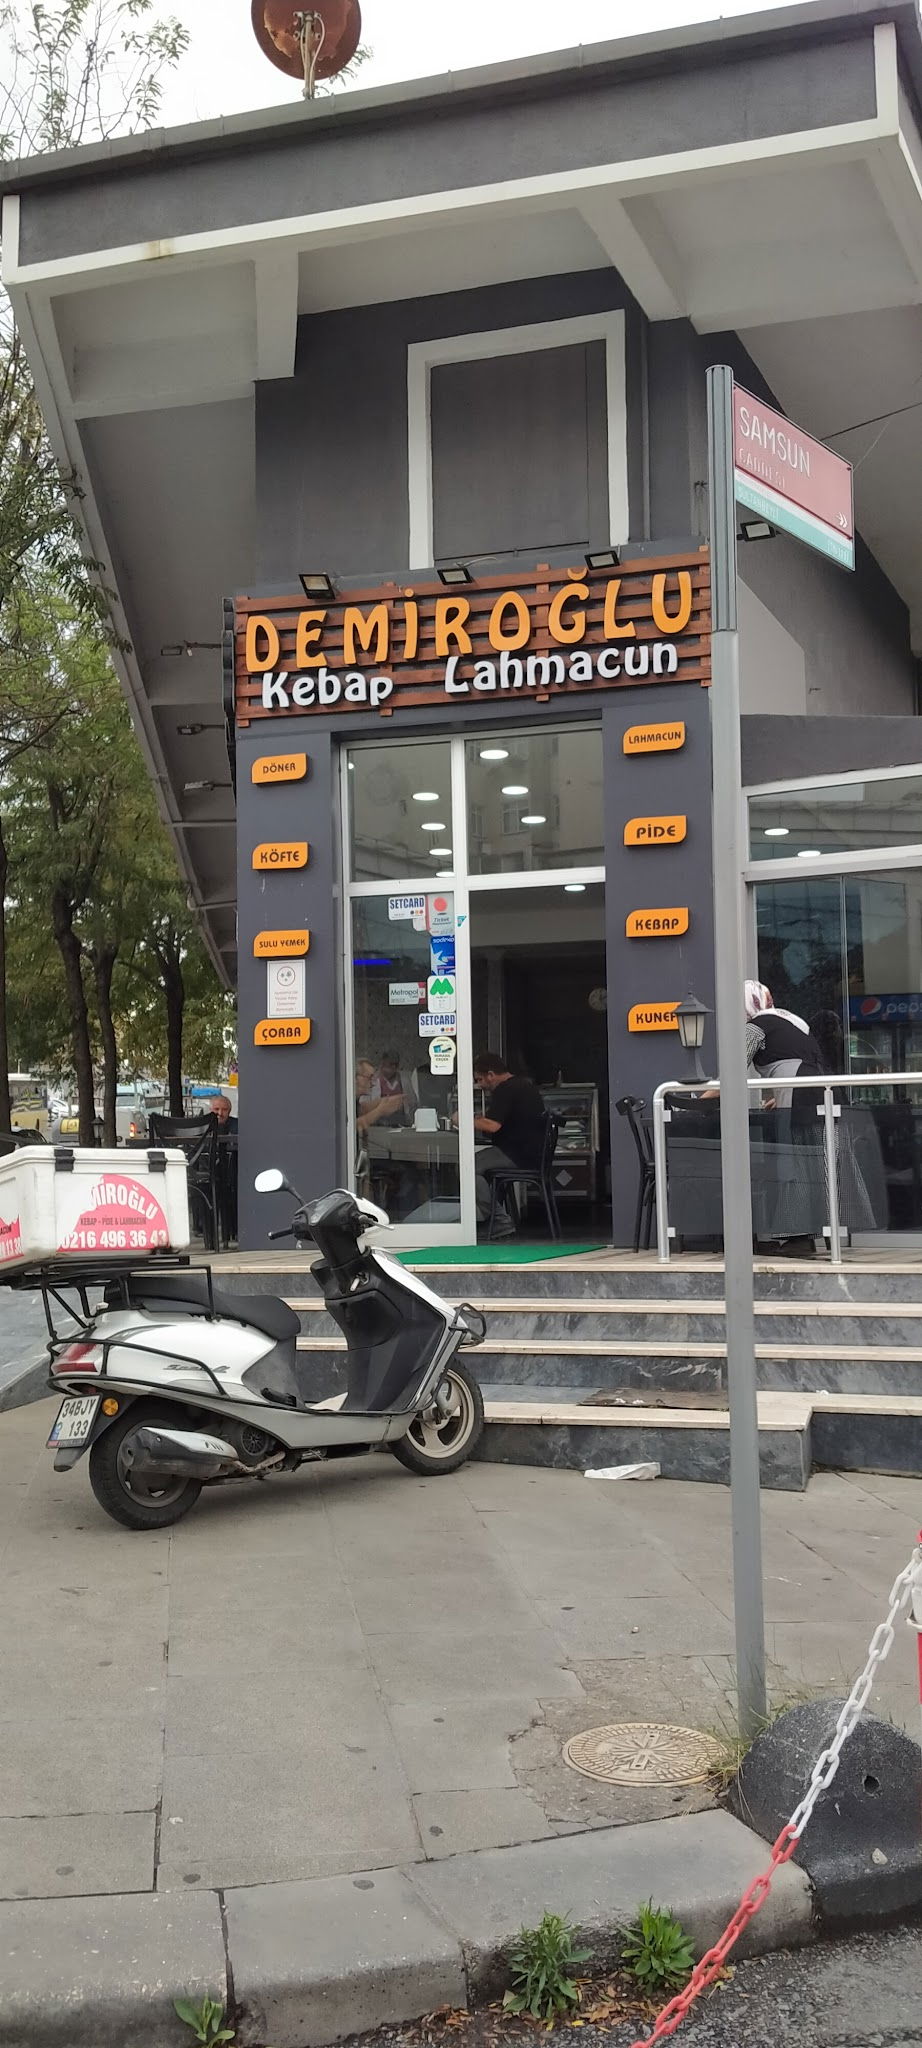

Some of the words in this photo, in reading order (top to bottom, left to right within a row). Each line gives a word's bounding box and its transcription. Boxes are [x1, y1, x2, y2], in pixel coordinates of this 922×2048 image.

[739, 407, 811, 476] SAMSUN
[245, 567, 693, 673] DEMİROĞLU
[261, 667, 394, 709] Kebap
[444, 642, 679, 694] Lahmacun
[628, 731, 682, 745] LAHMACUN
[262, 762, 296, 774] DÖNER
[636, 823, 677, 839] PİDE
[260, 848, 300, 863] KÖFTE
[390, 897, 425, 910] SETCARD
[635, 918, 679, 931] KEBAP
[259, 938, 278, 949] SULU
[280, 938, 306, 948] YEMEK
[390, 988, 419, 997] Metropol
[886, 1002, 922, 1015] pep
[420, 1014, 456, 1026] SETCARD
[636, 1011, 676, 1024] KUNEF
[262, 1027, 302, 1042] ÇORBA
[62, 1230, 97, 1249] 0216
[100, 1230, 126, 1248] 496
[129, 1230, 147, 1247] 36
[150, 1230, 167, 1248] 43
[62, 1398, 97, 1418] 34BJY
[68, 1420, 89, 1437] 133
